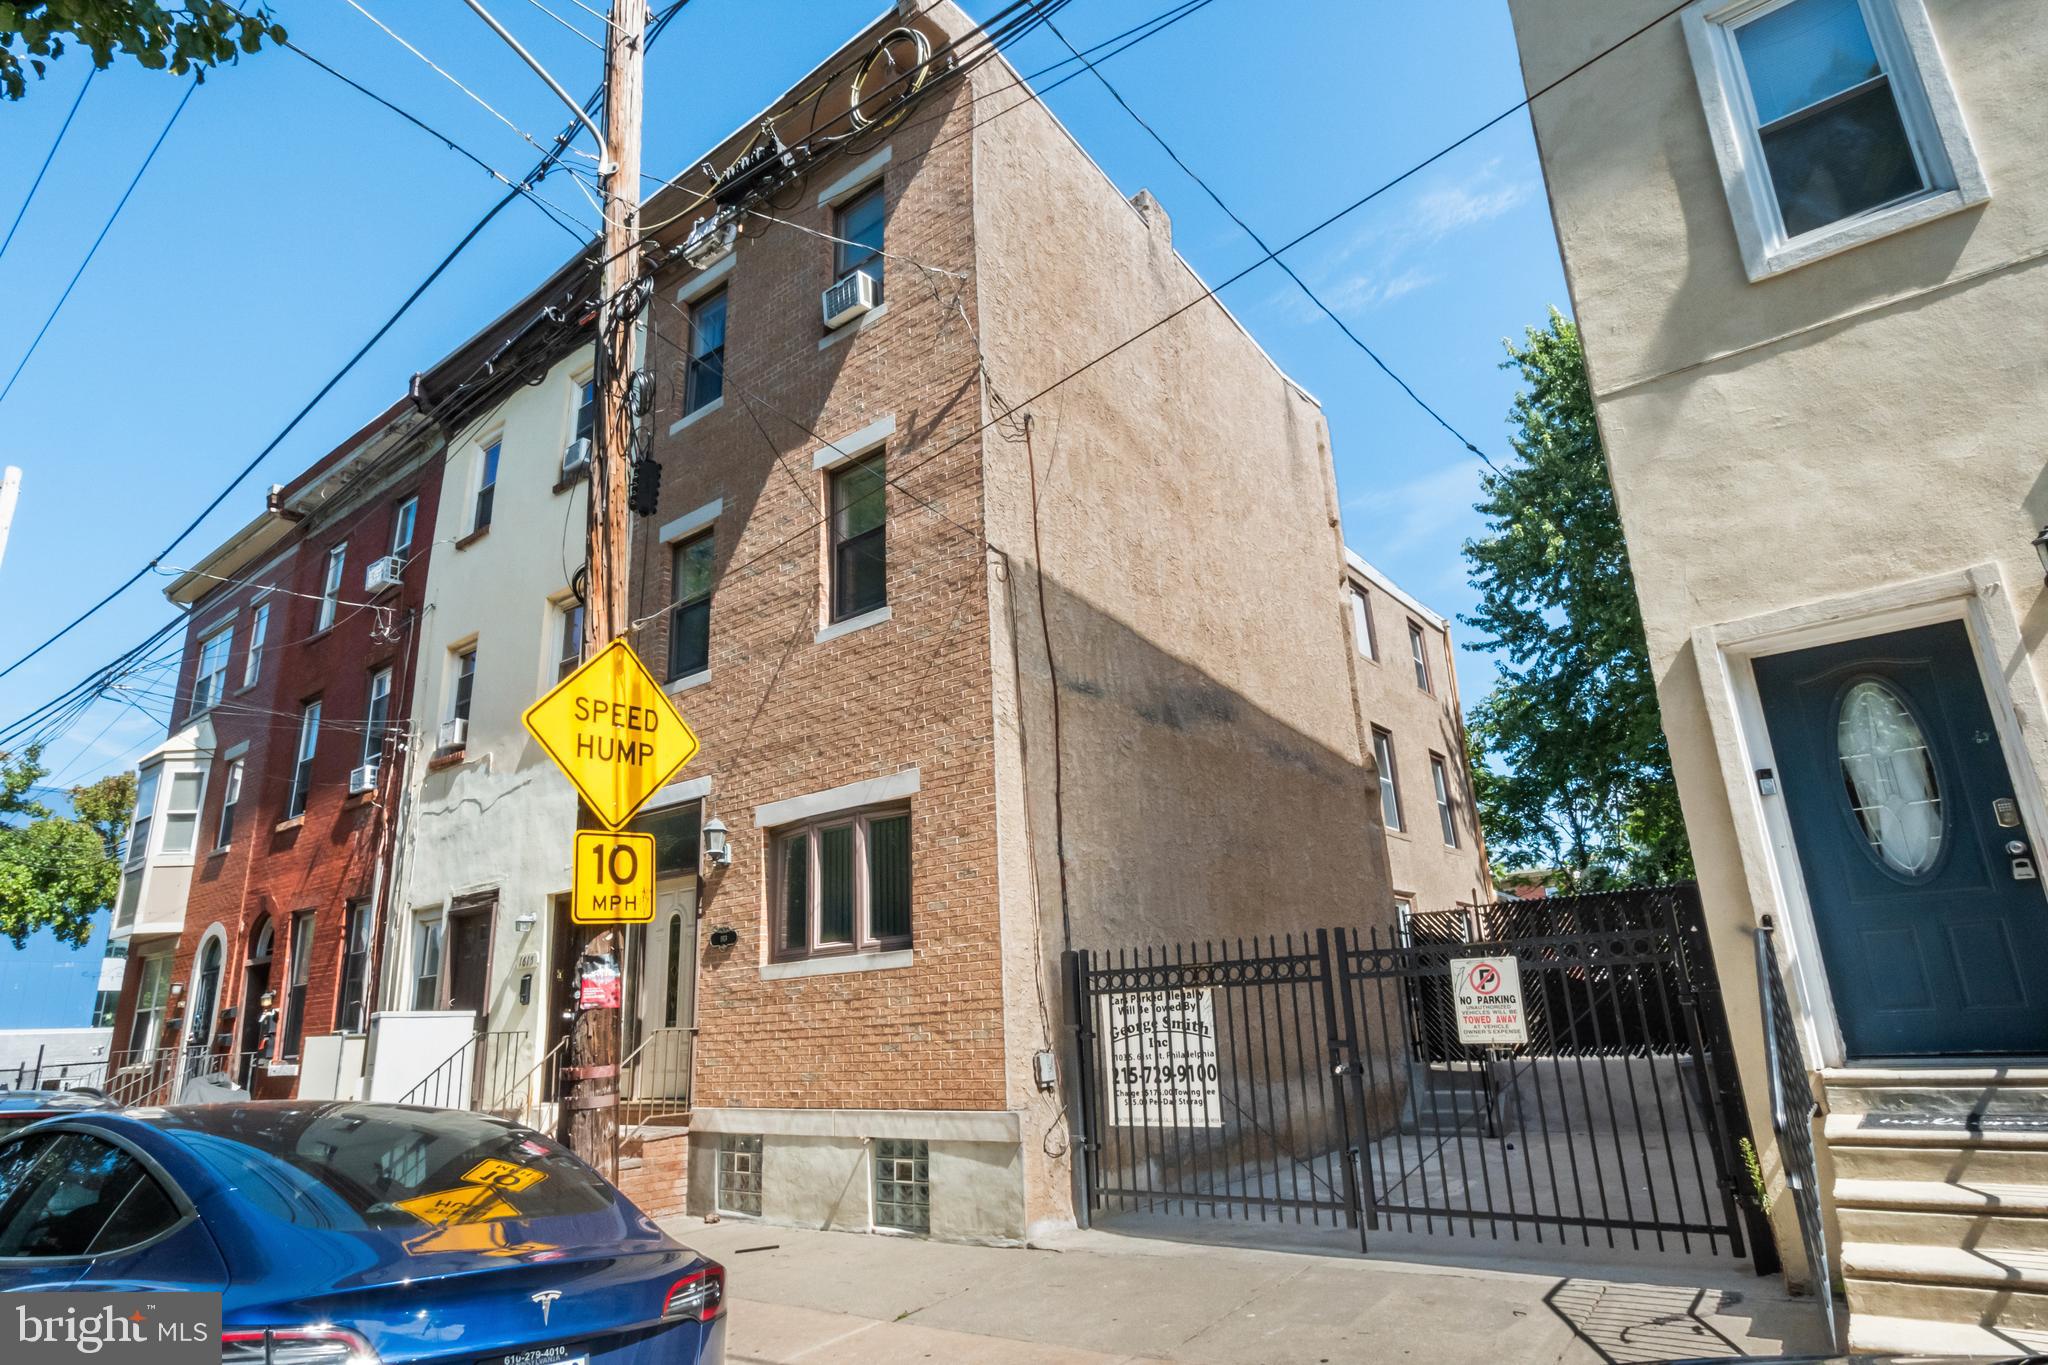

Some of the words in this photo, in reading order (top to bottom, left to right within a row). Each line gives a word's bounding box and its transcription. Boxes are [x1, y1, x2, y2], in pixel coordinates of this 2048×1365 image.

[574, 696, 658, 733] SPEED
[576, 732, 654, 767] HUMP
[592, 842, 638, 885] 10
[592, 895, 637, 911] MPH
[1131, 992, 1163, 1003] Prkd
[1166, 989, 1204, 1001] llealy
[1460, 996, 1472, 1005] NO
[1477, 994, 1516, 1004] PARKING
[1118, 1005, 1136, 1015] Will
[1153, 1002, 1181, 1012] owed
[1184, 1001, 1196, 1012] By
[1162, 1016, 1209, 1035] Smith
[1463, 1015, 1491, 1024] TOWED
[1496, 1014, 1517, 1023] AWAY
[1149, 1038, 1168, 1048] Inc
[1136, 1052, 1152, 1060] 6st
[1112, 1063, 1217, 1084] 215-729-9100
[1114, 1089, 1139, 1098] Chage
[1143, 1088, 1173, 1096] $17.00
[1174, 1088, 1200, 1097] Towng
[1178, 1097, 1206, 1107] Strag
